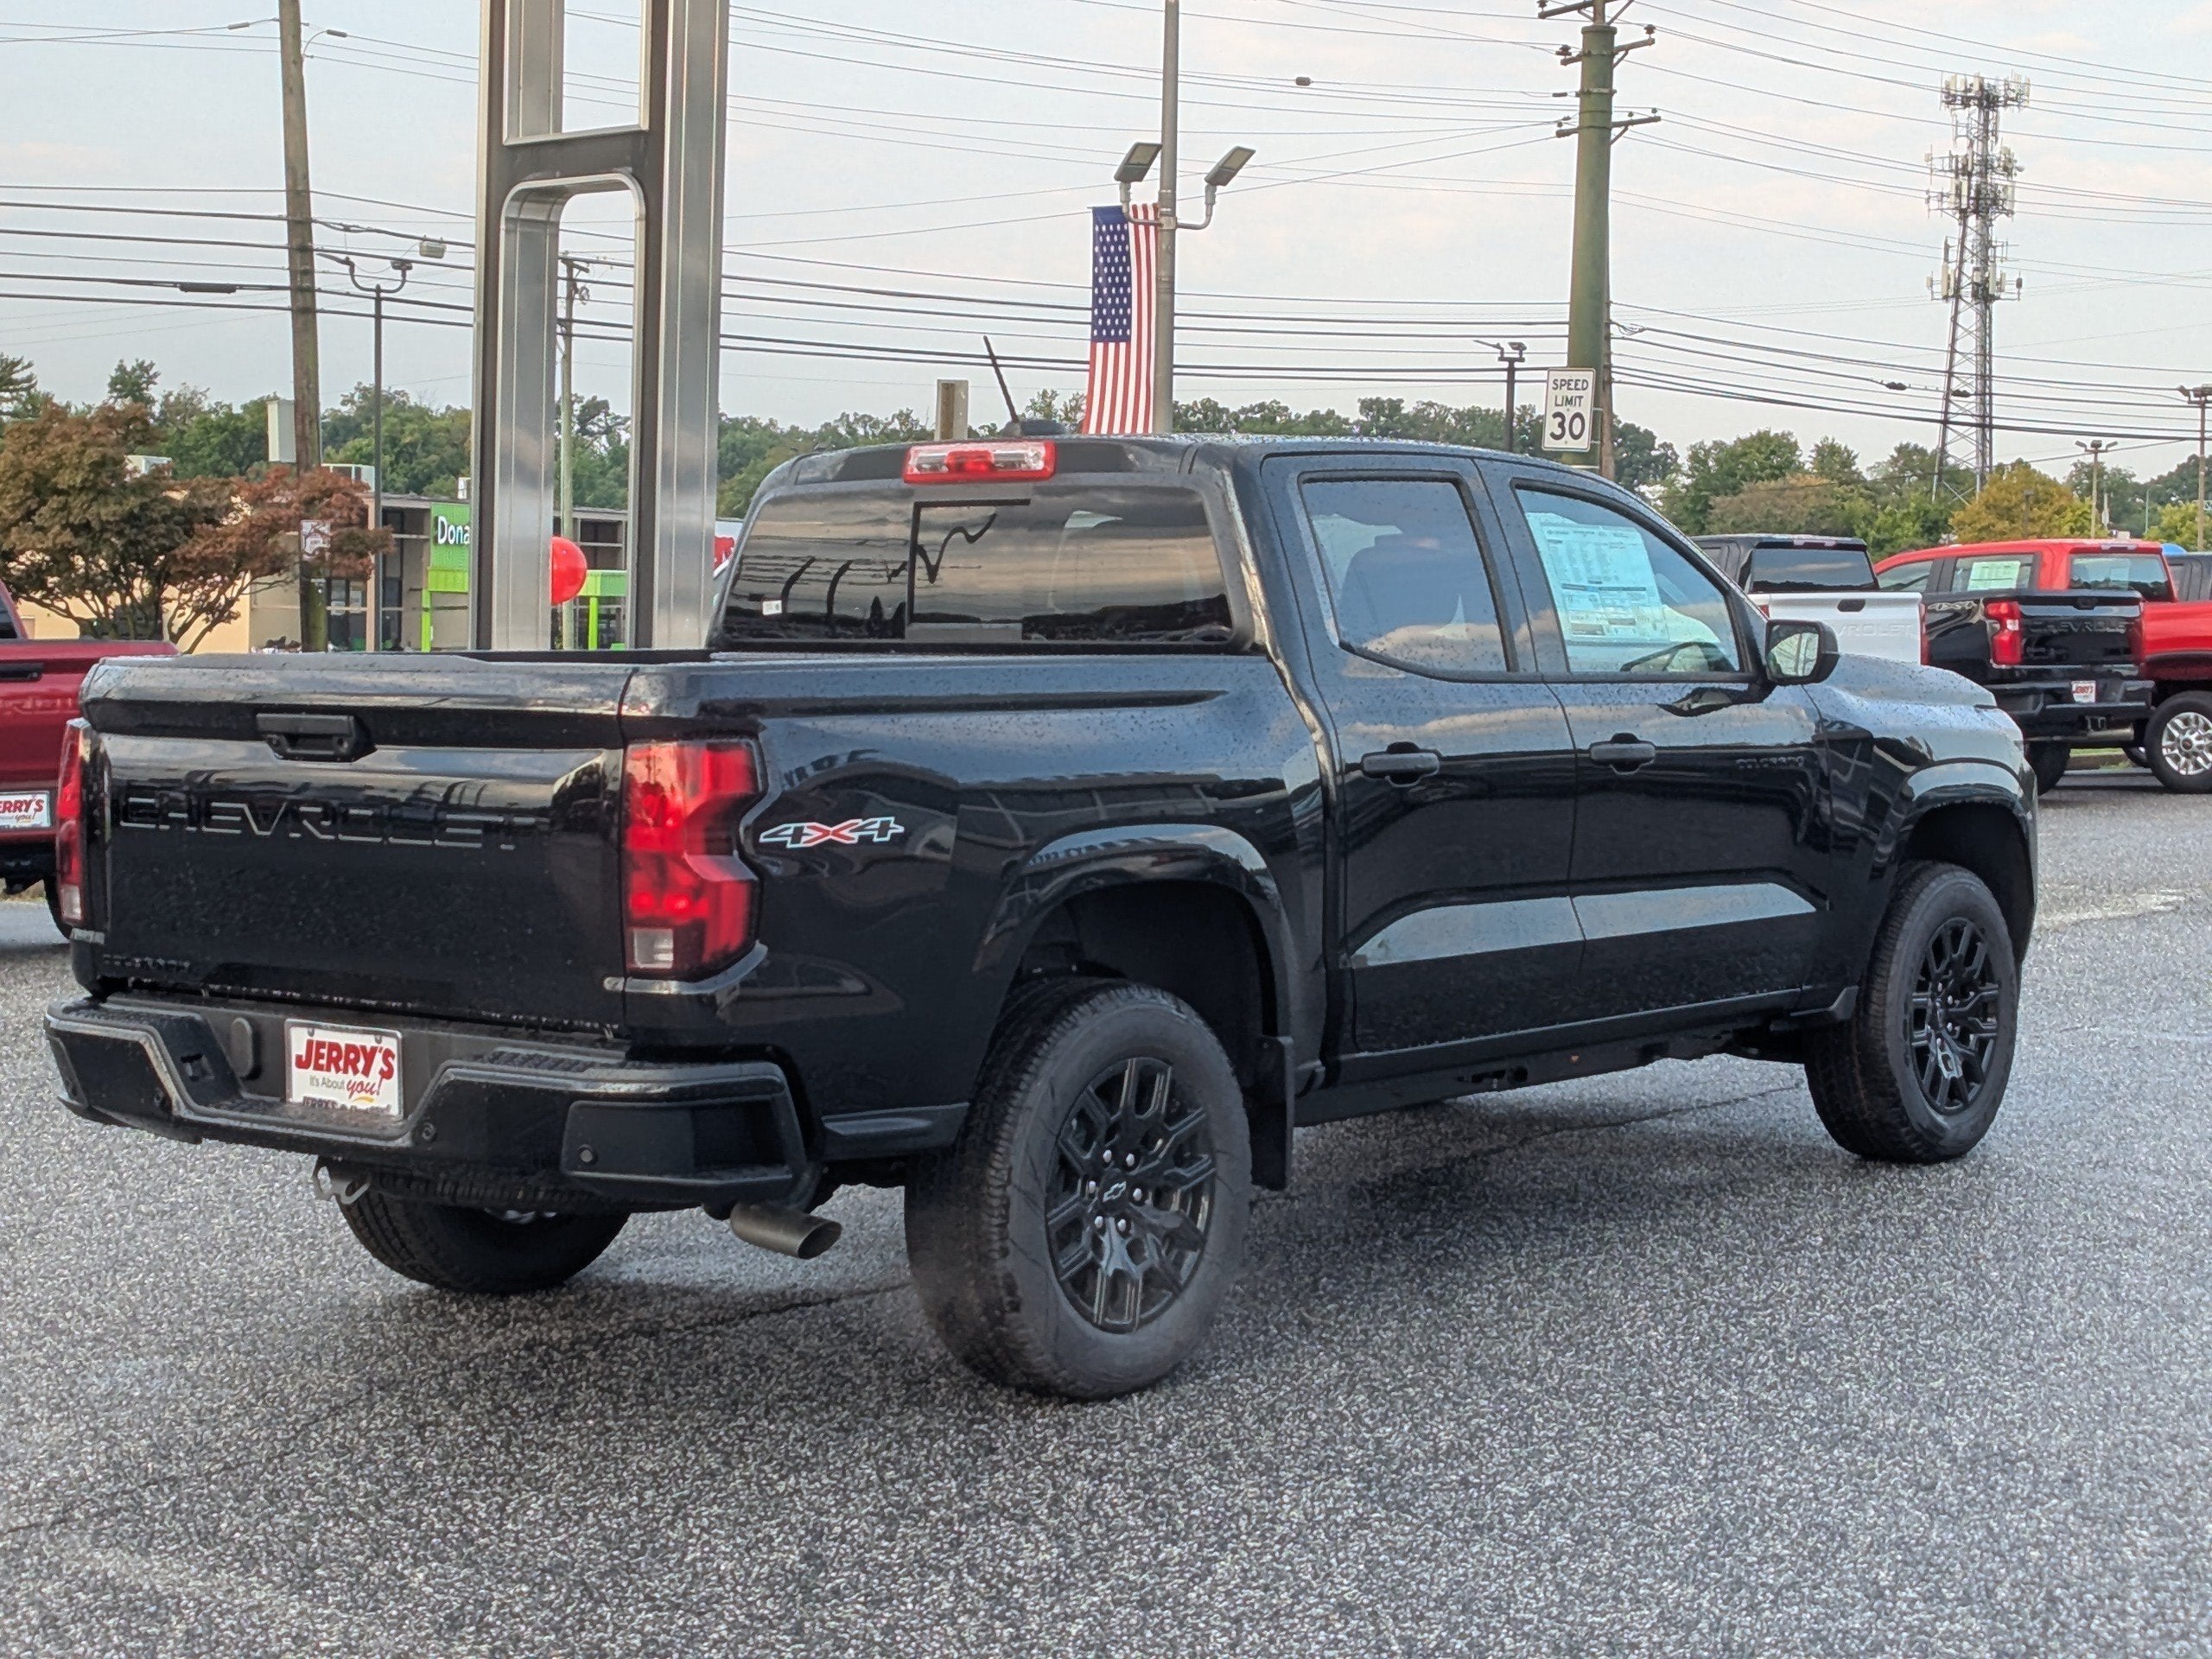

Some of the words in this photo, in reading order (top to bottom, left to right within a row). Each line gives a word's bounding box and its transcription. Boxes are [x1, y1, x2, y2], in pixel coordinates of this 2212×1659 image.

[1552, 378, 1589, 391] SPEED
[1554, 395, 1584, 407] LIMIT
[1549, 410, 1586, 441] 30
[437, 515, 470, 545] Dona
[119, 790, 541, 850] CHEVROLET
[295, 1039, 396, 1080] JERRY'S
[346, 1077, 383, 1100] you!
